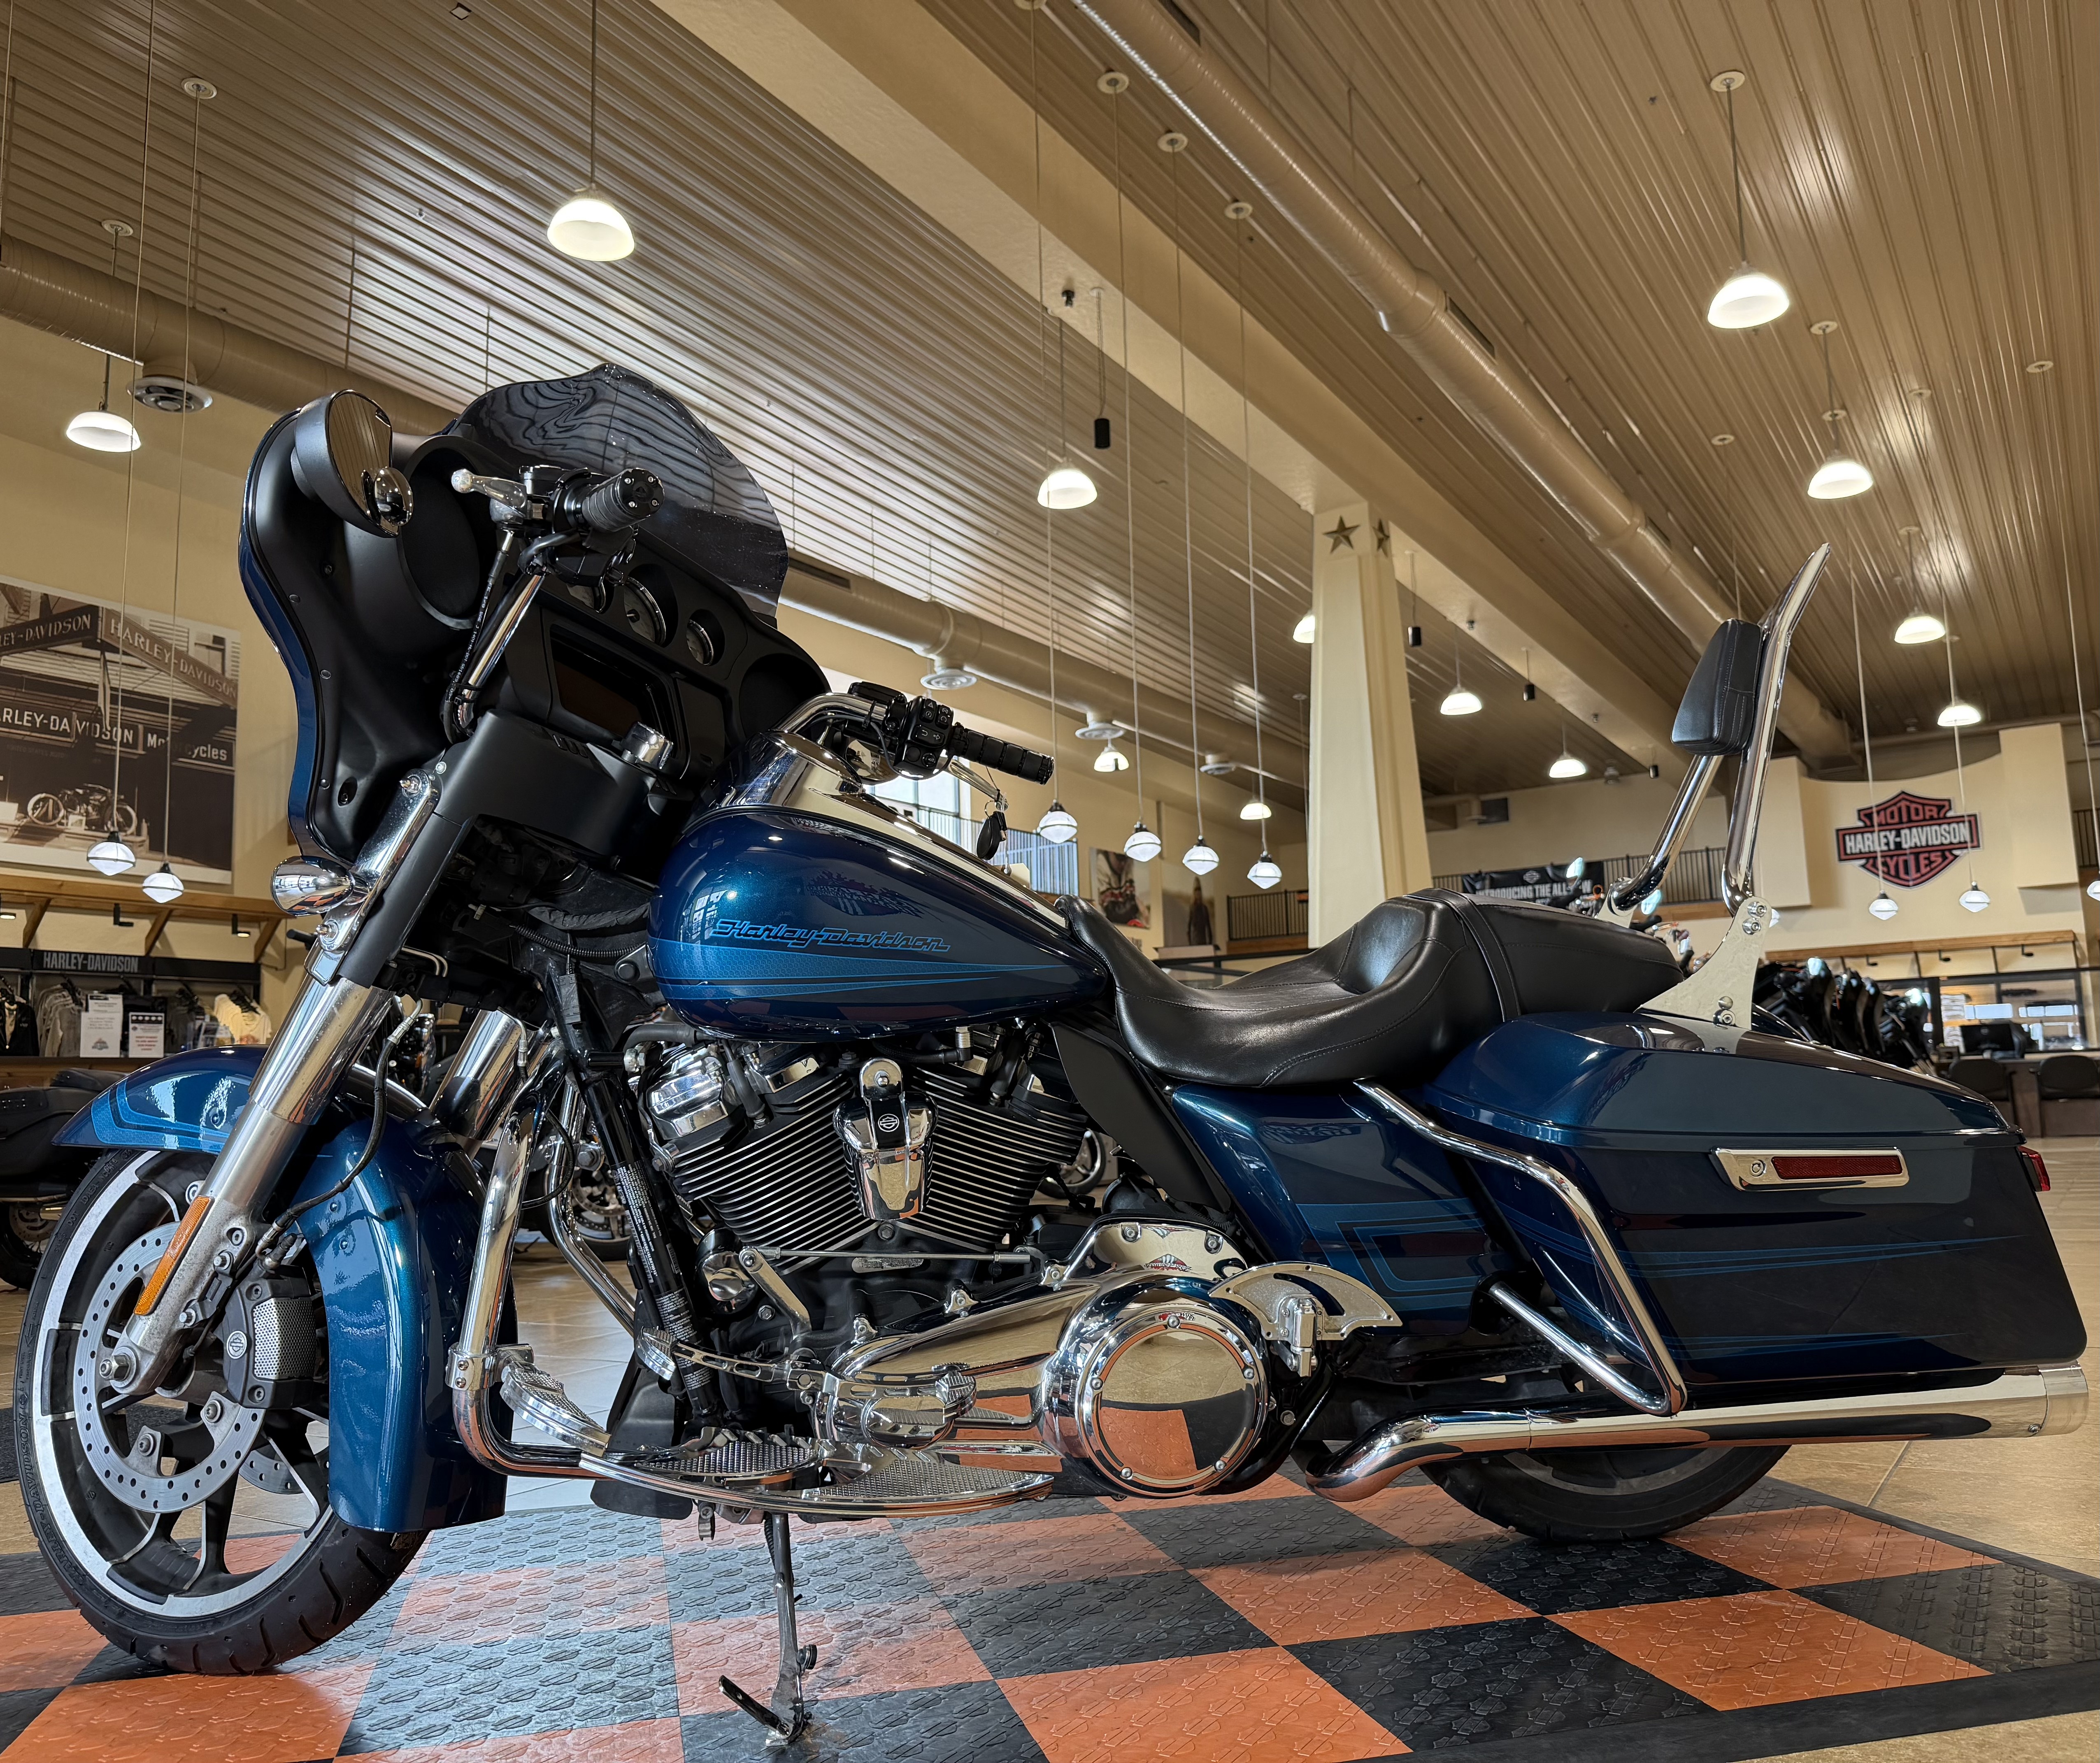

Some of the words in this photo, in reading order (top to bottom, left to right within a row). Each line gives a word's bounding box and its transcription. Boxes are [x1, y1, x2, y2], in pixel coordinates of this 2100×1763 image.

[110, 618, 236, 698] HARLEY-DAVIDSON
[0, 707, 133, 744] RLEY-DAVIDSON
[1876, 800, 1939, 826] MOTOR
[1844, 821, 1970, 854] HARLEY-DAVIDSON
[1877, 851, 1943, 880] CYCLES
[1534, 883, 1551, 898] THE
[709, 919, 951, 952] Harley-Davidson
[43, 951, 138, 973] HARLEY-DAVIDSON
[19, 1413, 85, 1585] HARLEY-DAVIDSON
